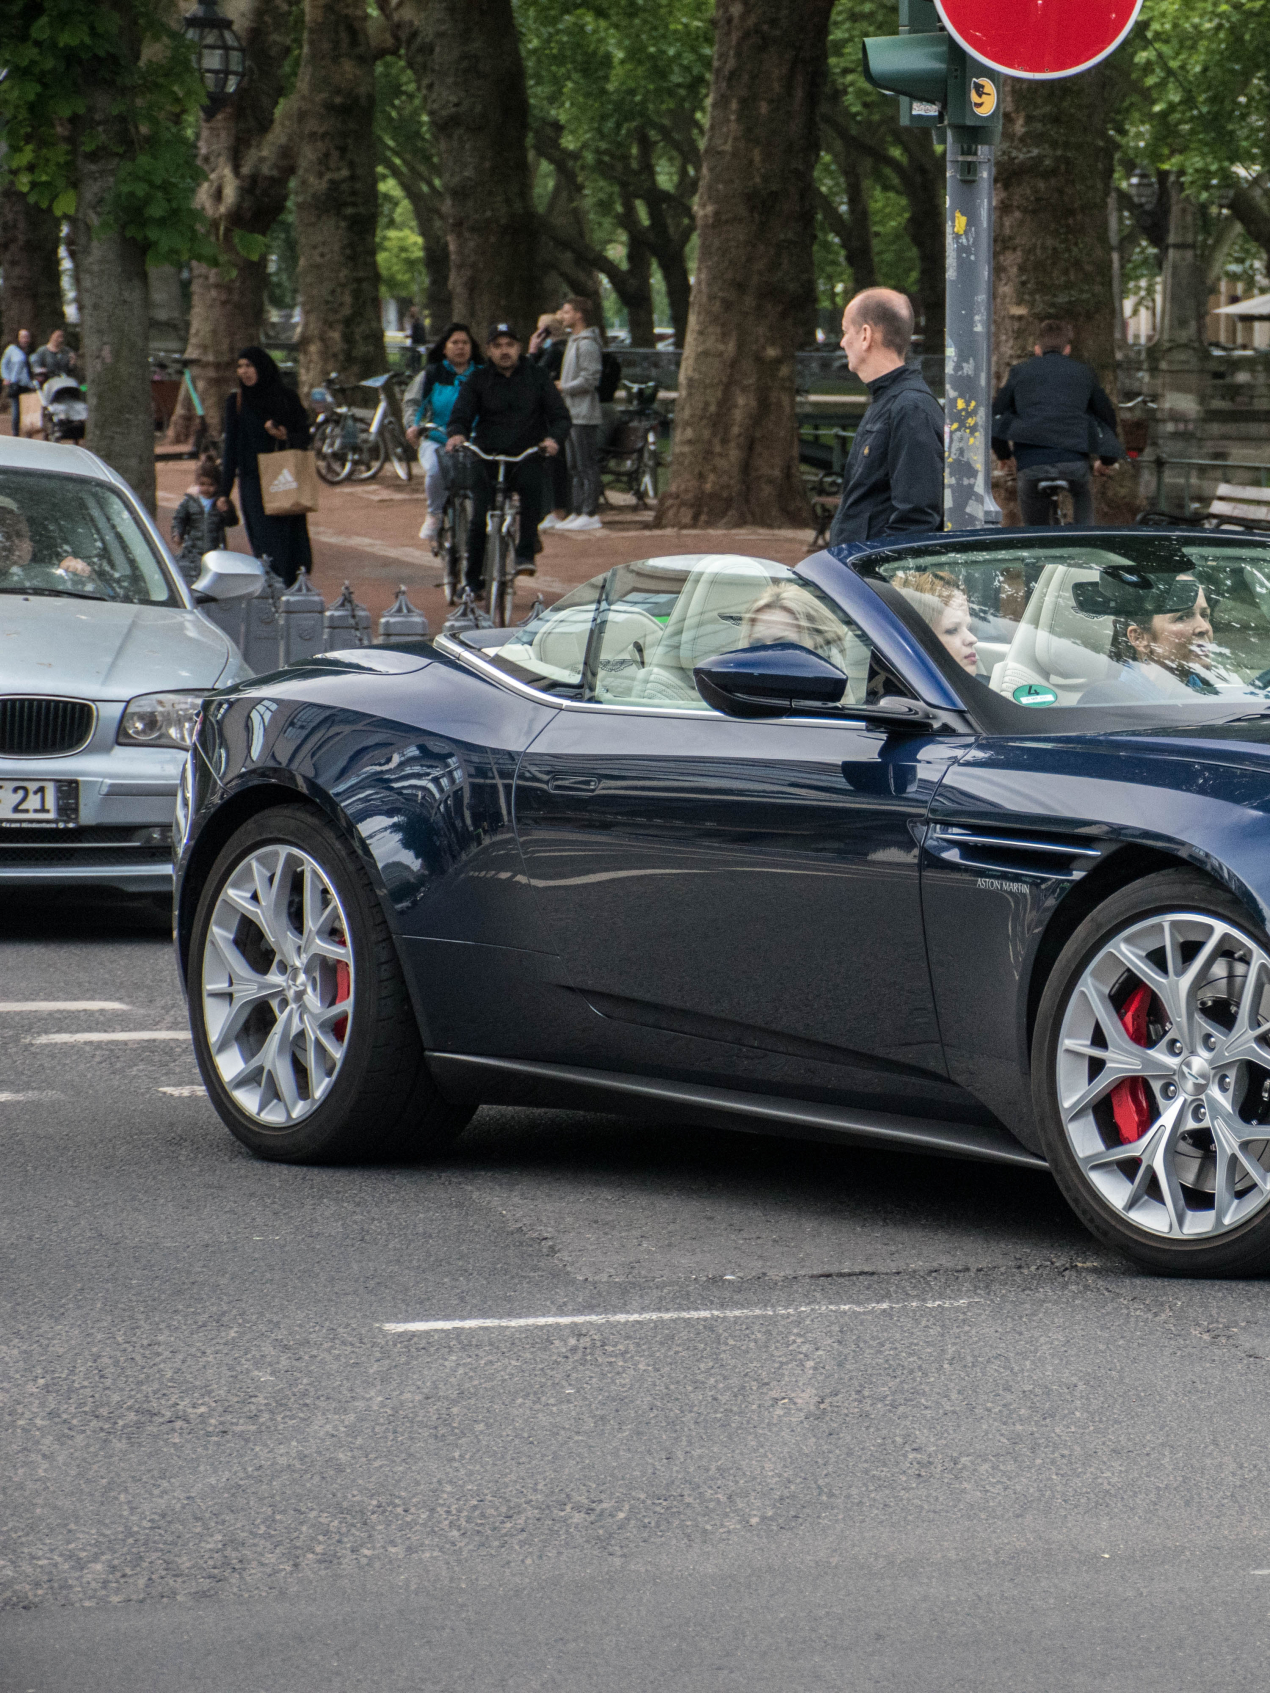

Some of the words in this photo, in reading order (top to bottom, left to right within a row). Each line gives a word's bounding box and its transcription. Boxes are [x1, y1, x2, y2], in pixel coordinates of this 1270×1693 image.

[1028, 685, 1039, 695] 4
[12, 785, 51, 814] 21
[976, 878, 1001, 890] ASTON
[1002, 881, 1030, 894] MARTIN
